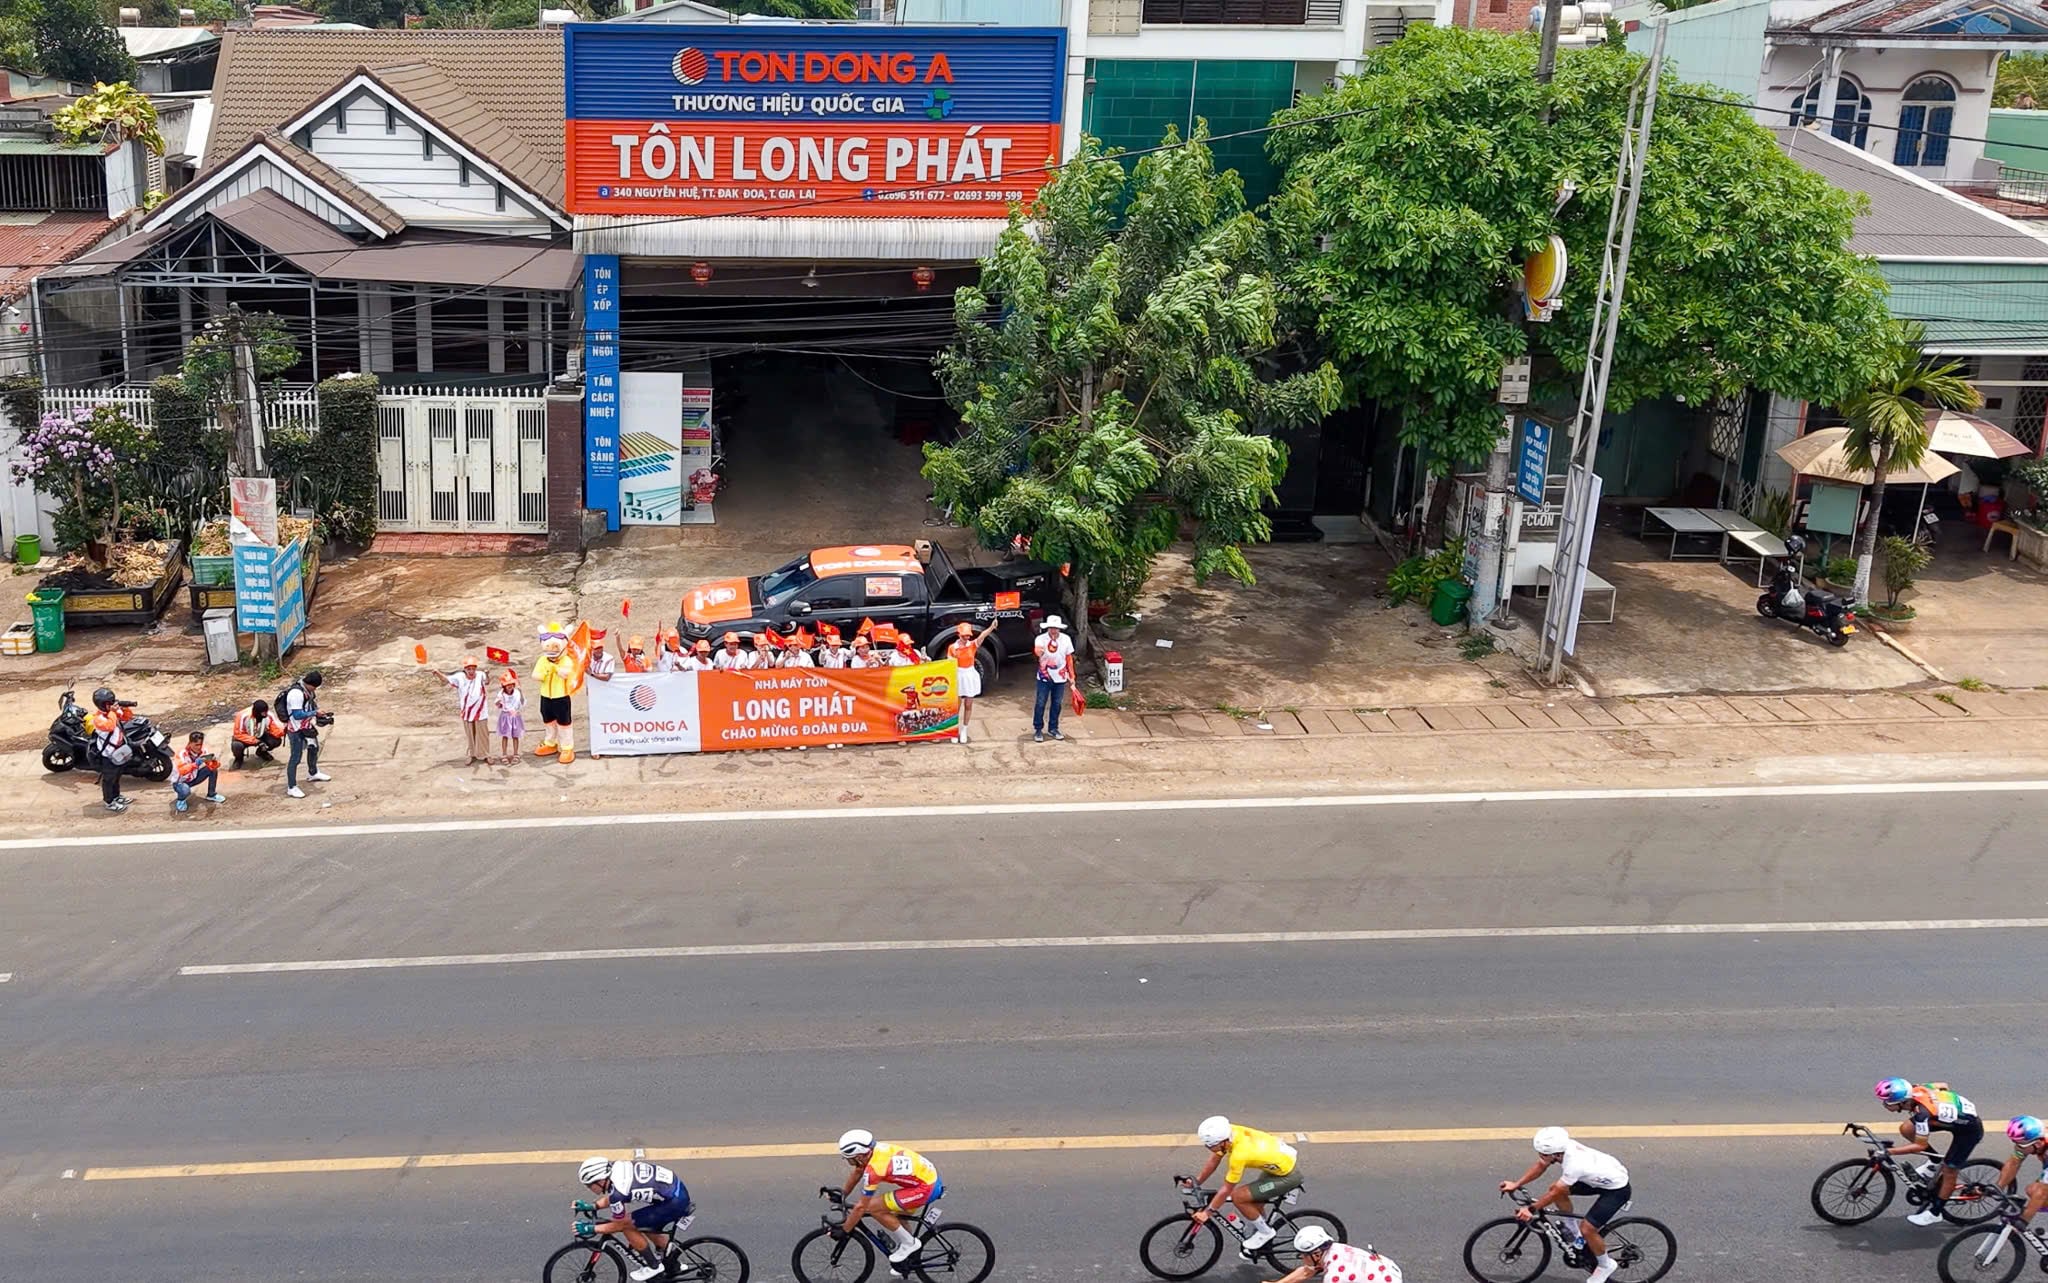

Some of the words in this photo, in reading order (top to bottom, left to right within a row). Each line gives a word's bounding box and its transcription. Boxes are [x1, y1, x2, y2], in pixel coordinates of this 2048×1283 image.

[714, 51, 796, 83] TON
[803, 52, 915, 84] DONG
[924, 52, 955, 84] A
[672, 94, 756, 112] THƯƠNG
[762, 92, 804, 116] HIỆU
[810, 92, 865, 116] QUỐC
[871, 97, 905, 113] GIA
[611, 122, 714, 181] TÔN
[732, 135, 870, 182] LONG
[885, 125, 1012, 183] PHÁT
[613, 187, 632, 197] 340
[635, 184, 676, 198] NGUYỄN
[702, 188, 716, 198] TT.
[718, 188, 739, 199] ĐAK
[778, 189, 795, 199] GIA
[799, 189, 816, 199] LAI
[953, 191, 982, 200] 02693
[985, 191, 1001, 201] 599
[1004, 191, 1023, 201] 599
[596, 282, 609, 295] ÉP
[591, 390, 615, 402] CÁCH
[589, 406, 615, 419] NHIỆT
[590, 450, 615, 462] SÁNG
[754, 678, 779, 690] NHÀ
[780, 677, 803, 689] MÁY
[804, 676, 829, 688] TÔN
[732, 697, 791, 722] LONG
[799, 690, 857, 718] PHÁT
[600, 722, 631, 734] TON
[634, 720, 676, 733] DONG
[678, 719, 688, 731] A
[721, 725, 757, 740] CHÀO
[760, 723, 799, 738] MỪNG
[802, 721, 838, 735] ĐOÀN
[841, 721, 868, 733] ĐUA
[895, 1158, 910, 1171] 27
[634, 1190, 651, 1202] 97
